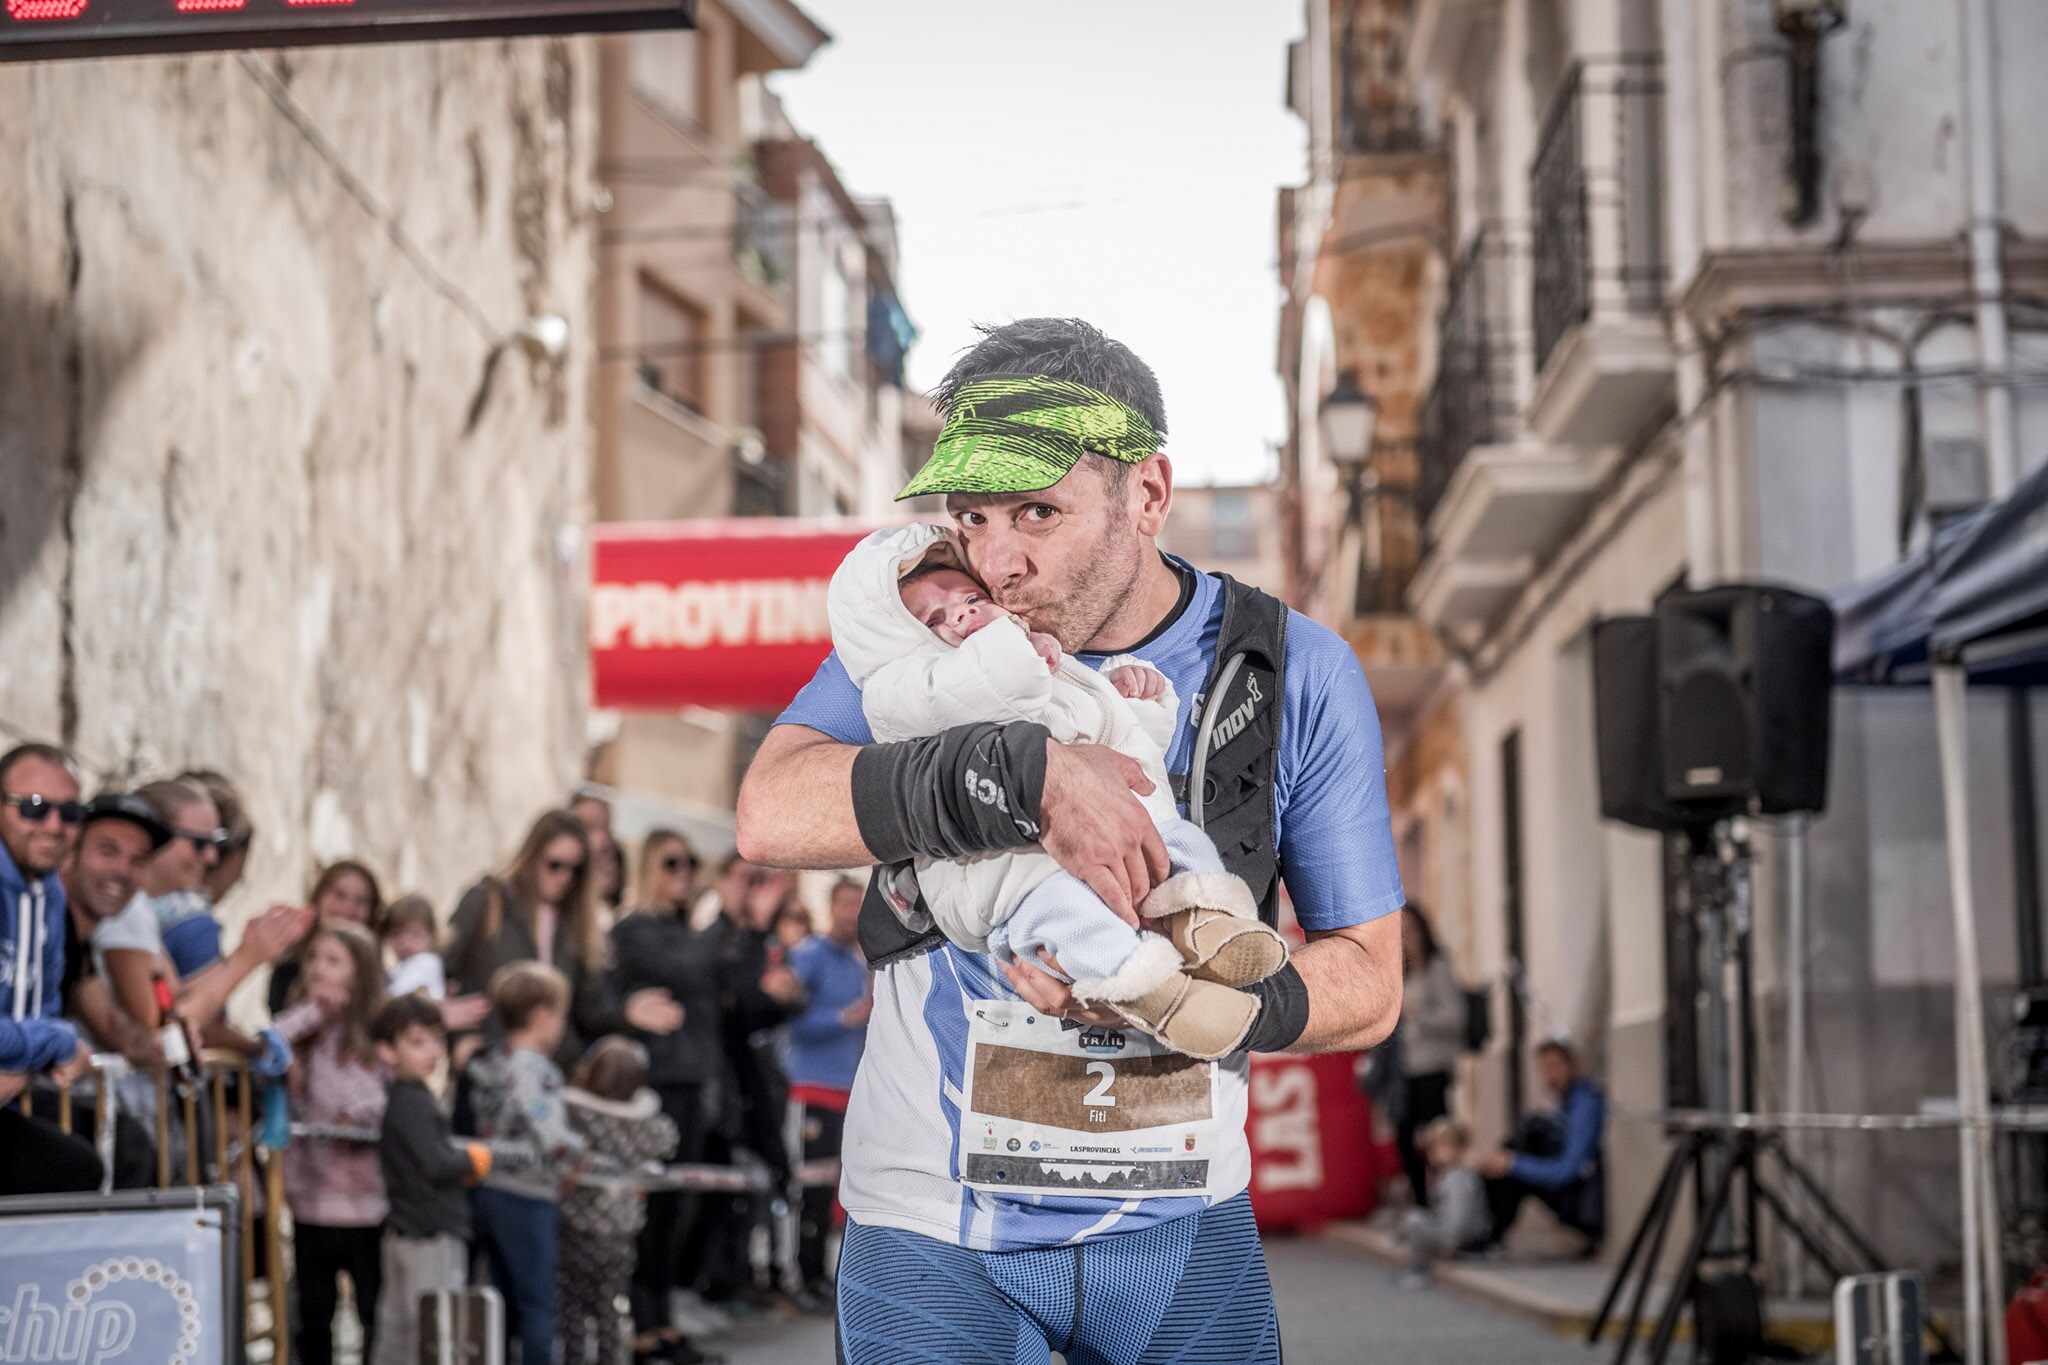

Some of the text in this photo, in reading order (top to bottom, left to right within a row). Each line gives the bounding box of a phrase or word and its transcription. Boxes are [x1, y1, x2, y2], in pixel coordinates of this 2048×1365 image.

[1083, 1061, 1116, 1106] 2
[1089, 1109, 1107, 1122] Fiti
[1070, 1146, 1121, 1154] LASPROVINCIAS
